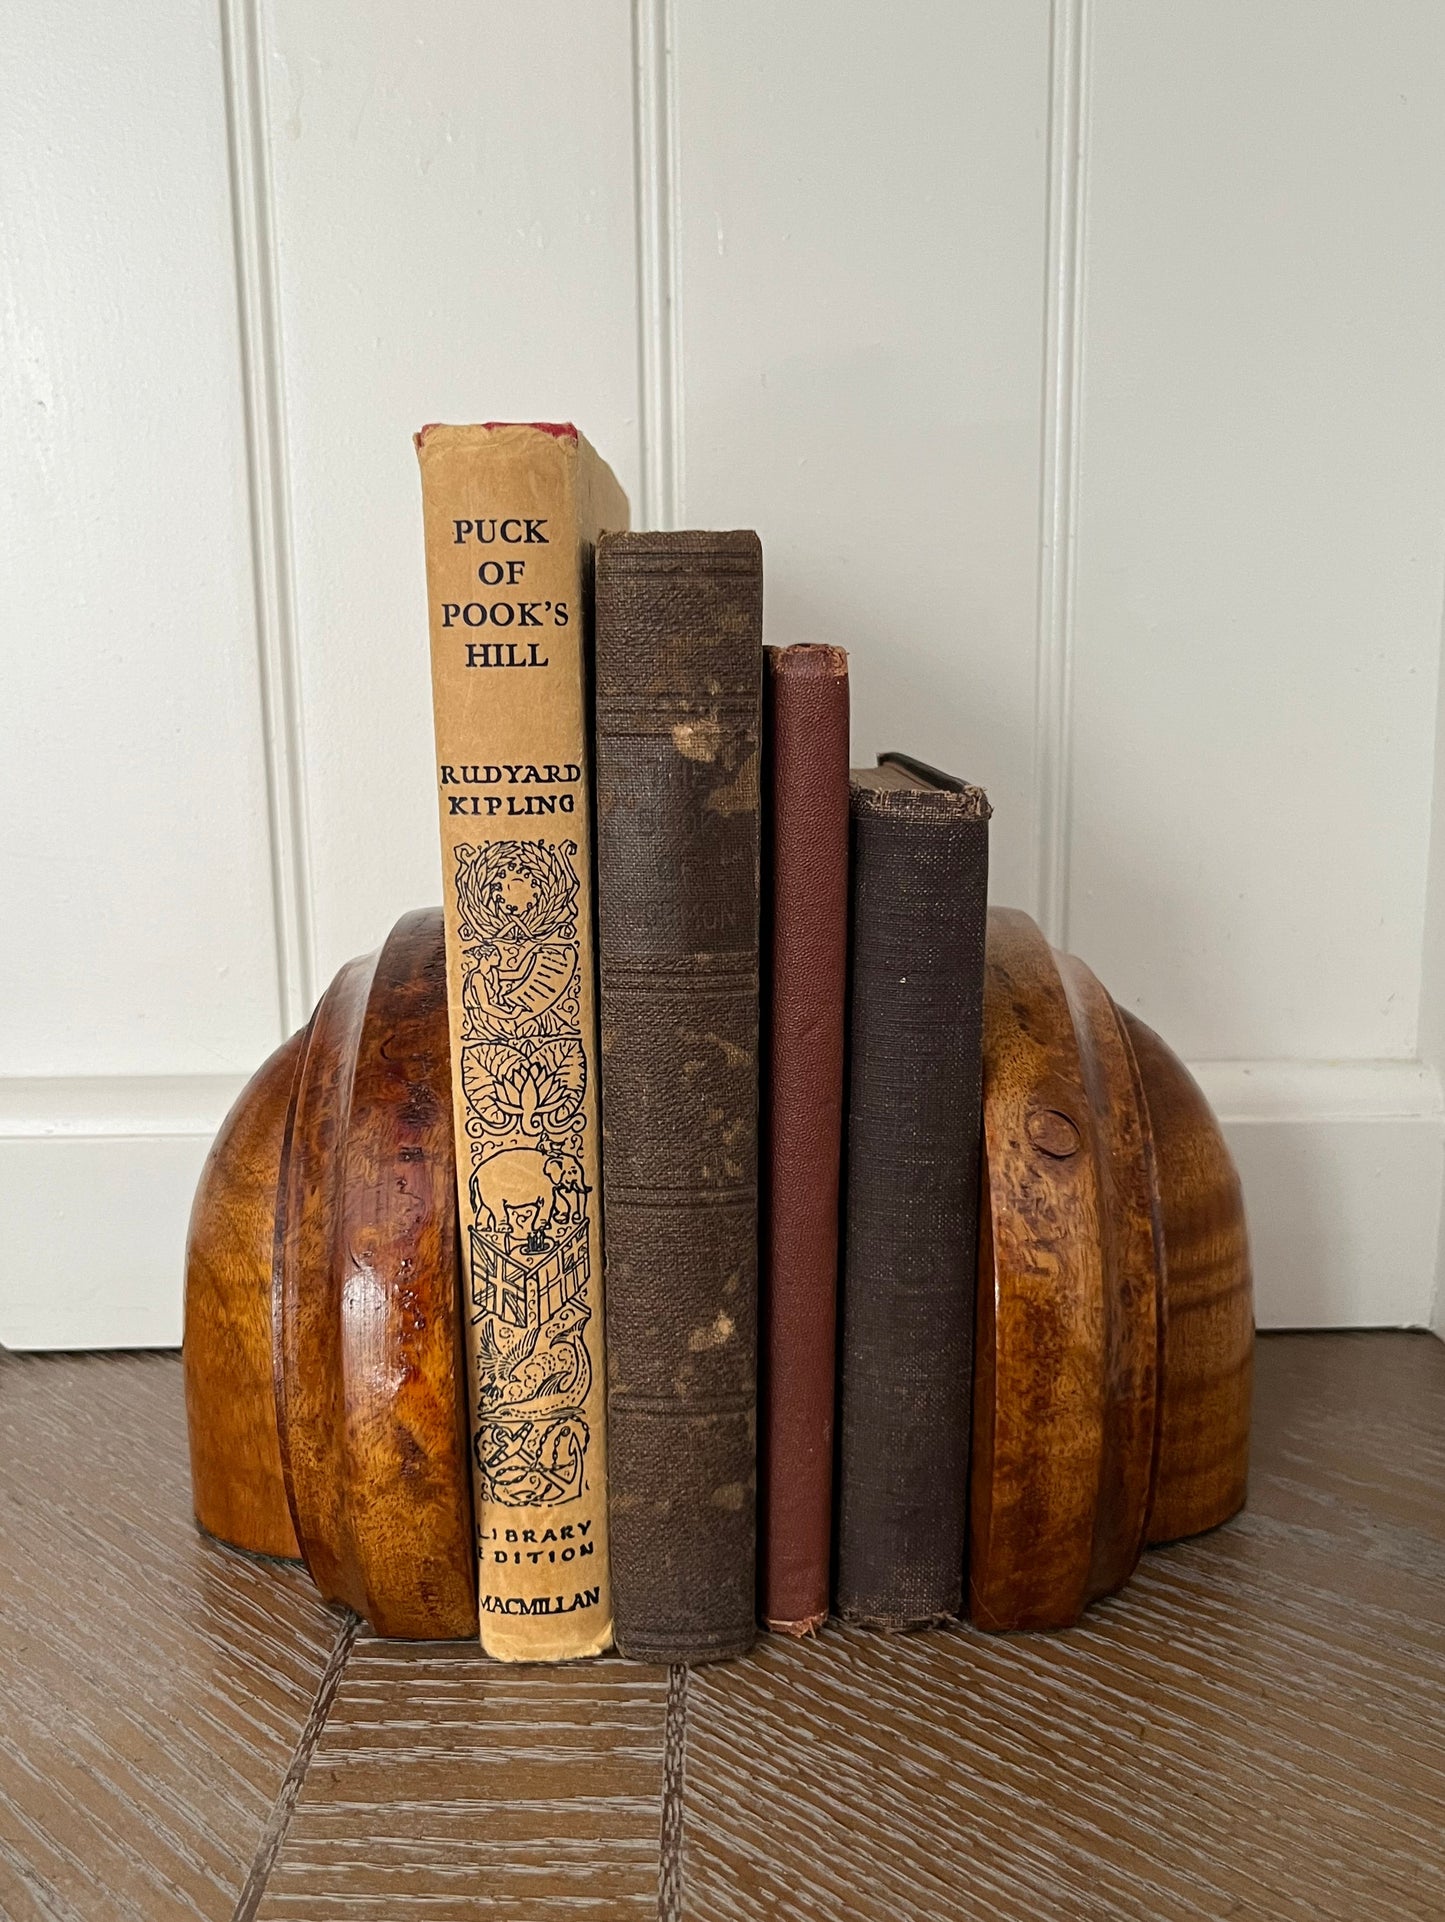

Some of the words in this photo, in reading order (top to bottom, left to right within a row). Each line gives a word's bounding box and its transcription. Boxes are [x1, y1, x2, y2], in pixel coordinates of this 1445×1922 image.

[453, 519, 549, 543] PUCK
[479, 561, 525, 585] OF
[442, 601, 568, 627] POOK'S
[465, 644, 548, 667] HILL
[441, 764, 582, 785] RUDYARD
[448, 794, 574, 815] KIPLING
[481, 1587, 600, 1614] MACMILLAN
